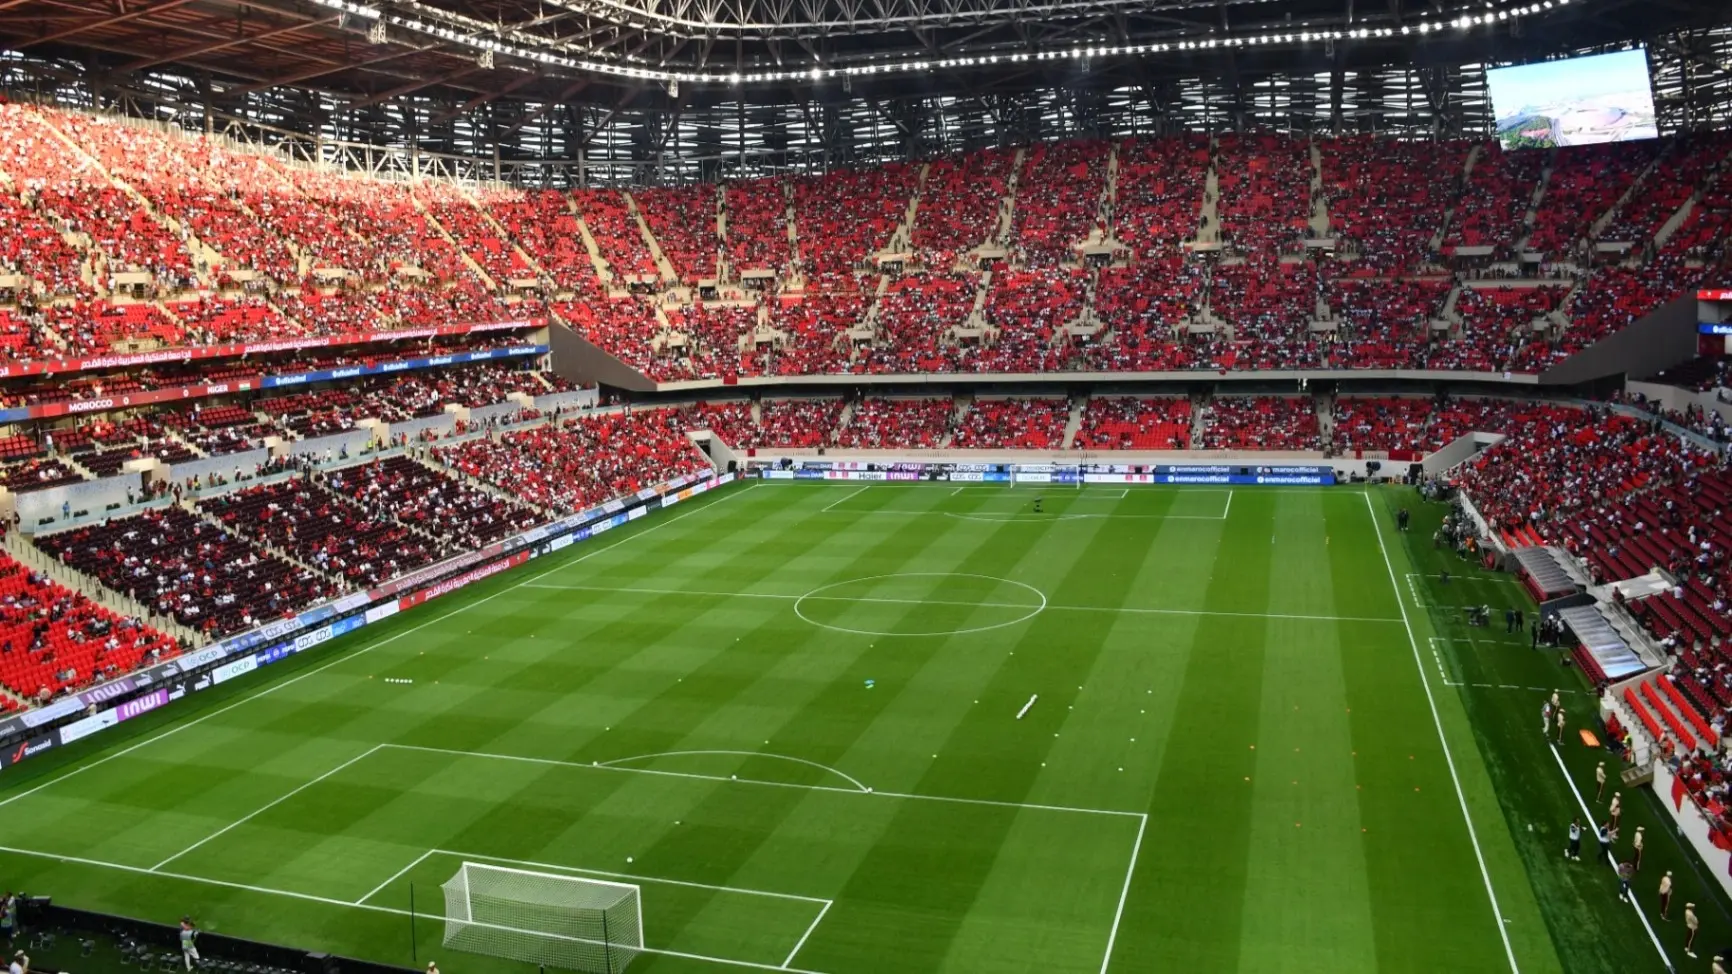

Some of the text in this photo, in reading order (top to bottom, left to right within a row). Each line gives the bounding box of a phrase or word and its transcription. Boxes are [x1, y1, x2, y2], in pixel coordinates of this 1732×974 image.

[69, 384, 228, 412] MOROCCO 0 0 NIGER
[858, 472, 882, 480] Haier
[199, 650, 218, 662] OCP
[231, 661, 250, 673] OCP
[86, 681, 129, 702] inwi
[124, 693, 161, 717] inwi
[24, 738, 52, 755] Sonasid
